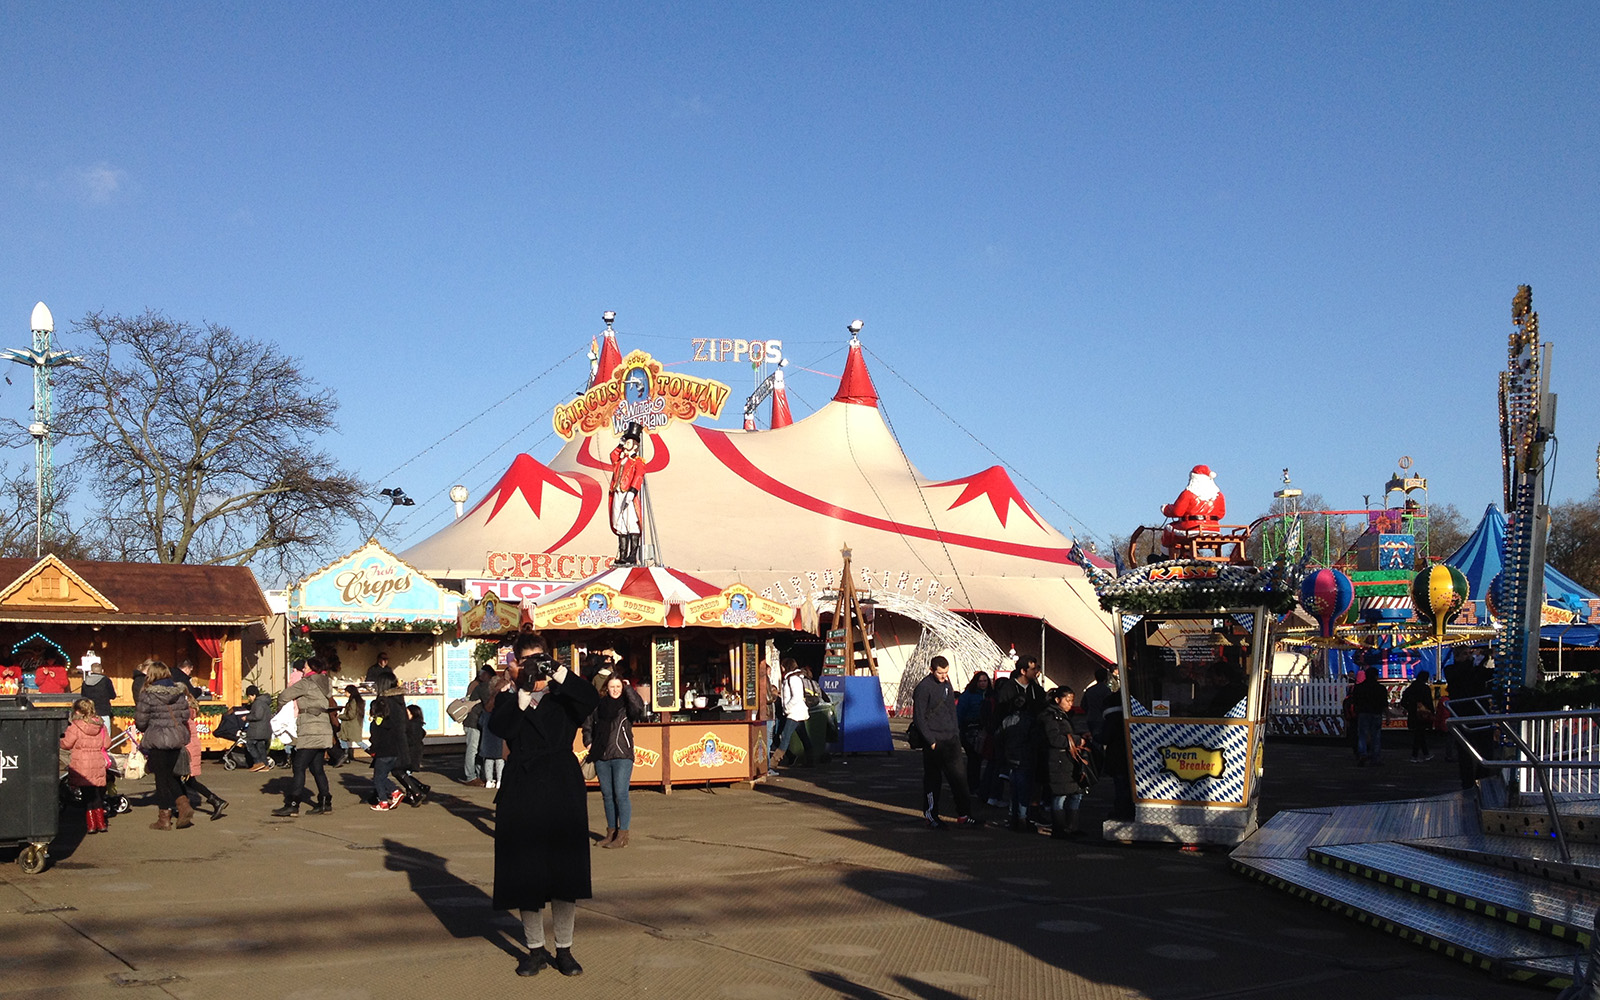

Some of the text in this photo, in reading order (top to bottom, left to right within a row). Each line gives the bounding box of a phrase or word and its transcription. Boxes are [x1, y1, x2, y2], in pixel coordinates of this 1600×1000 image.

[691, 338, 783, 363] ZIPPOS
[554, 381, 622, 438] CIRCUS
[656, 375, 729, 417] TOWN
[1148, 565, 1219, 581] KASSE
[335, 570, 412, 604] Crepes
[760, 567, 845, 601] ZIPPO
[622, 600, 656, 615] COOKIES
[823, 680, 840, 689] MAP
[1165, 749, 1197, 762] Bayern
[1179, 760, 1216, 771] Breaker
